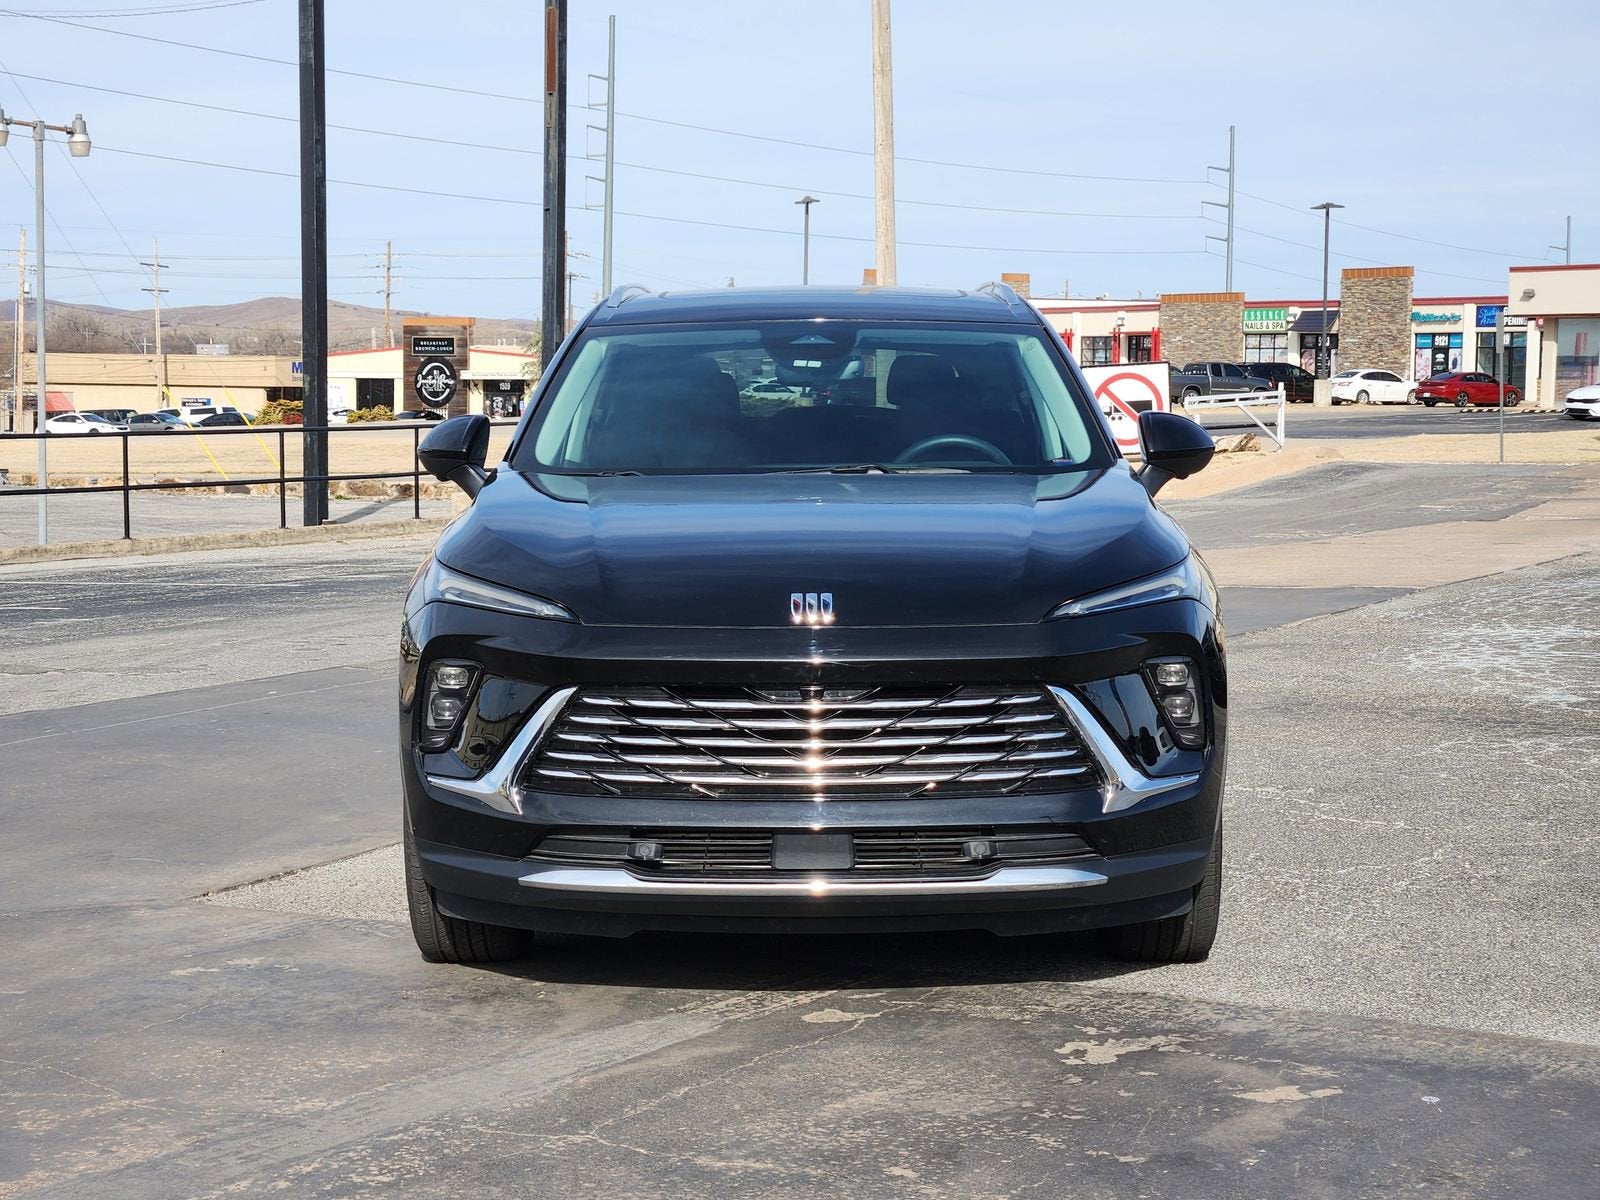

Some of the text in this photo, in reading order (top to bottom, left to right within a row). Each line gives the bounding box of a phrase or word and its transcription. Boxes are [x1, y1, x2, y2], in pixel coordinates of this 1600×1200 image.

[1244, 310, 1285, 320] ESSENCE
[1503, 316, 1528, 325] PENING
[1245, 321, 1284, 330] NAILS & SPA
[1434, 335, 1449, 346] 5121
